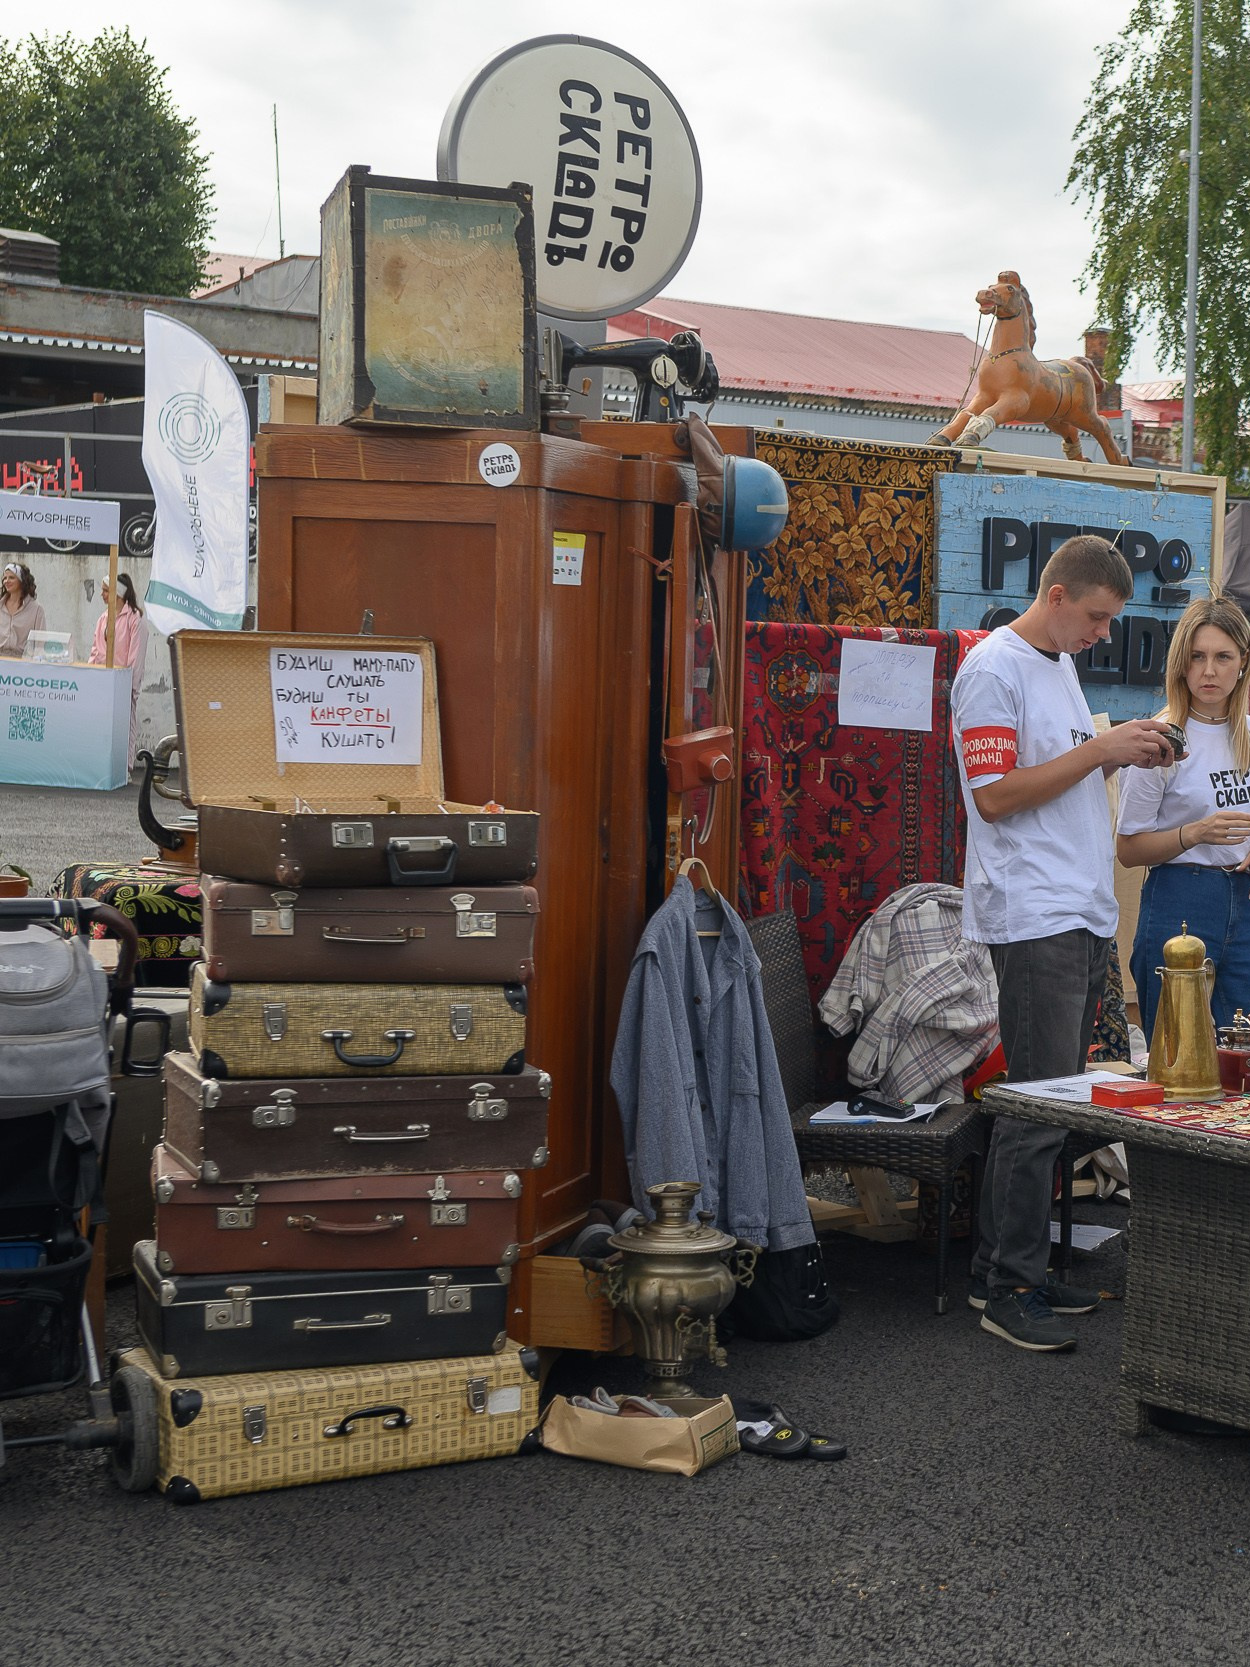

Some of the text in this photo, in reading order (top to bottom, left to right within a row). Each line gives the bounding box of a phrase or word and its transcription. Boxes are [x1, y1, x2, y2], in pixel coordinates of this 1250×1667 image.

[467, 223, 504, 240] ДВОРА
[483, 454, 514, 467] РЕТРО
[6, 509, 91, 528] ATMOSPHERE
[277, 654, 416, 673] БУДИШ МАМУ-ПАПУ
[327, 674, 385, 689] СЛУШАТЬ
[14, 689, 46, 700] МЕСТО
